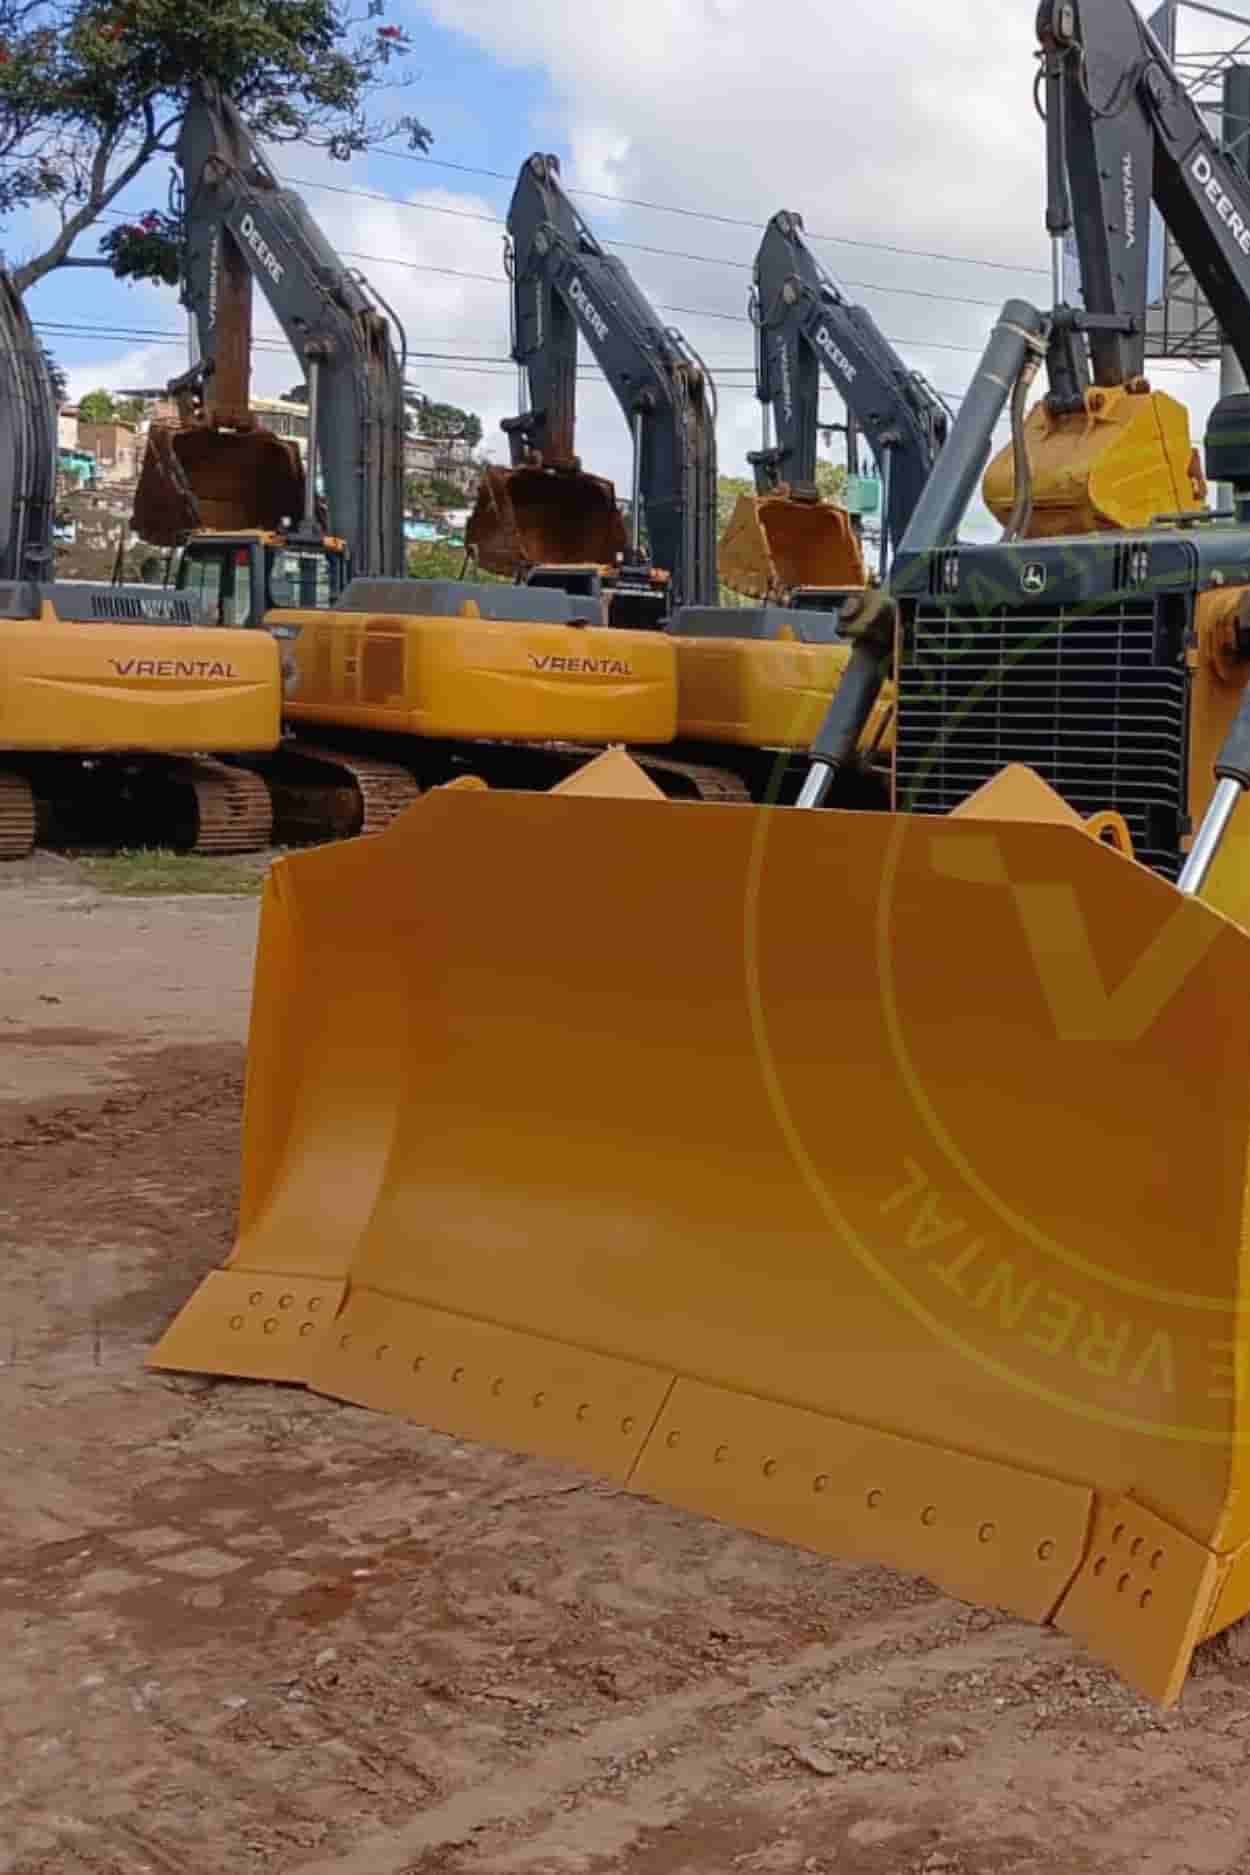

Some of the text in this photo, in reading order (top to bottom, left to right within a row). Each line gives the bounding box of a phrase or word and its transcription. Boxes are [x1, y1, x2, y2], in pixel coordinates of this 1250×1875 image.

[1121, 151, 1136, 249] VRENTAL
[240, 212, 285, 284] DEERE
[568, 276, 608, 342] DEERE
[815, 326, 857, 383] DEERE
[108, 658, 239, 679] VRENTAL
[528, 653, 634, 676] VRENTAL
